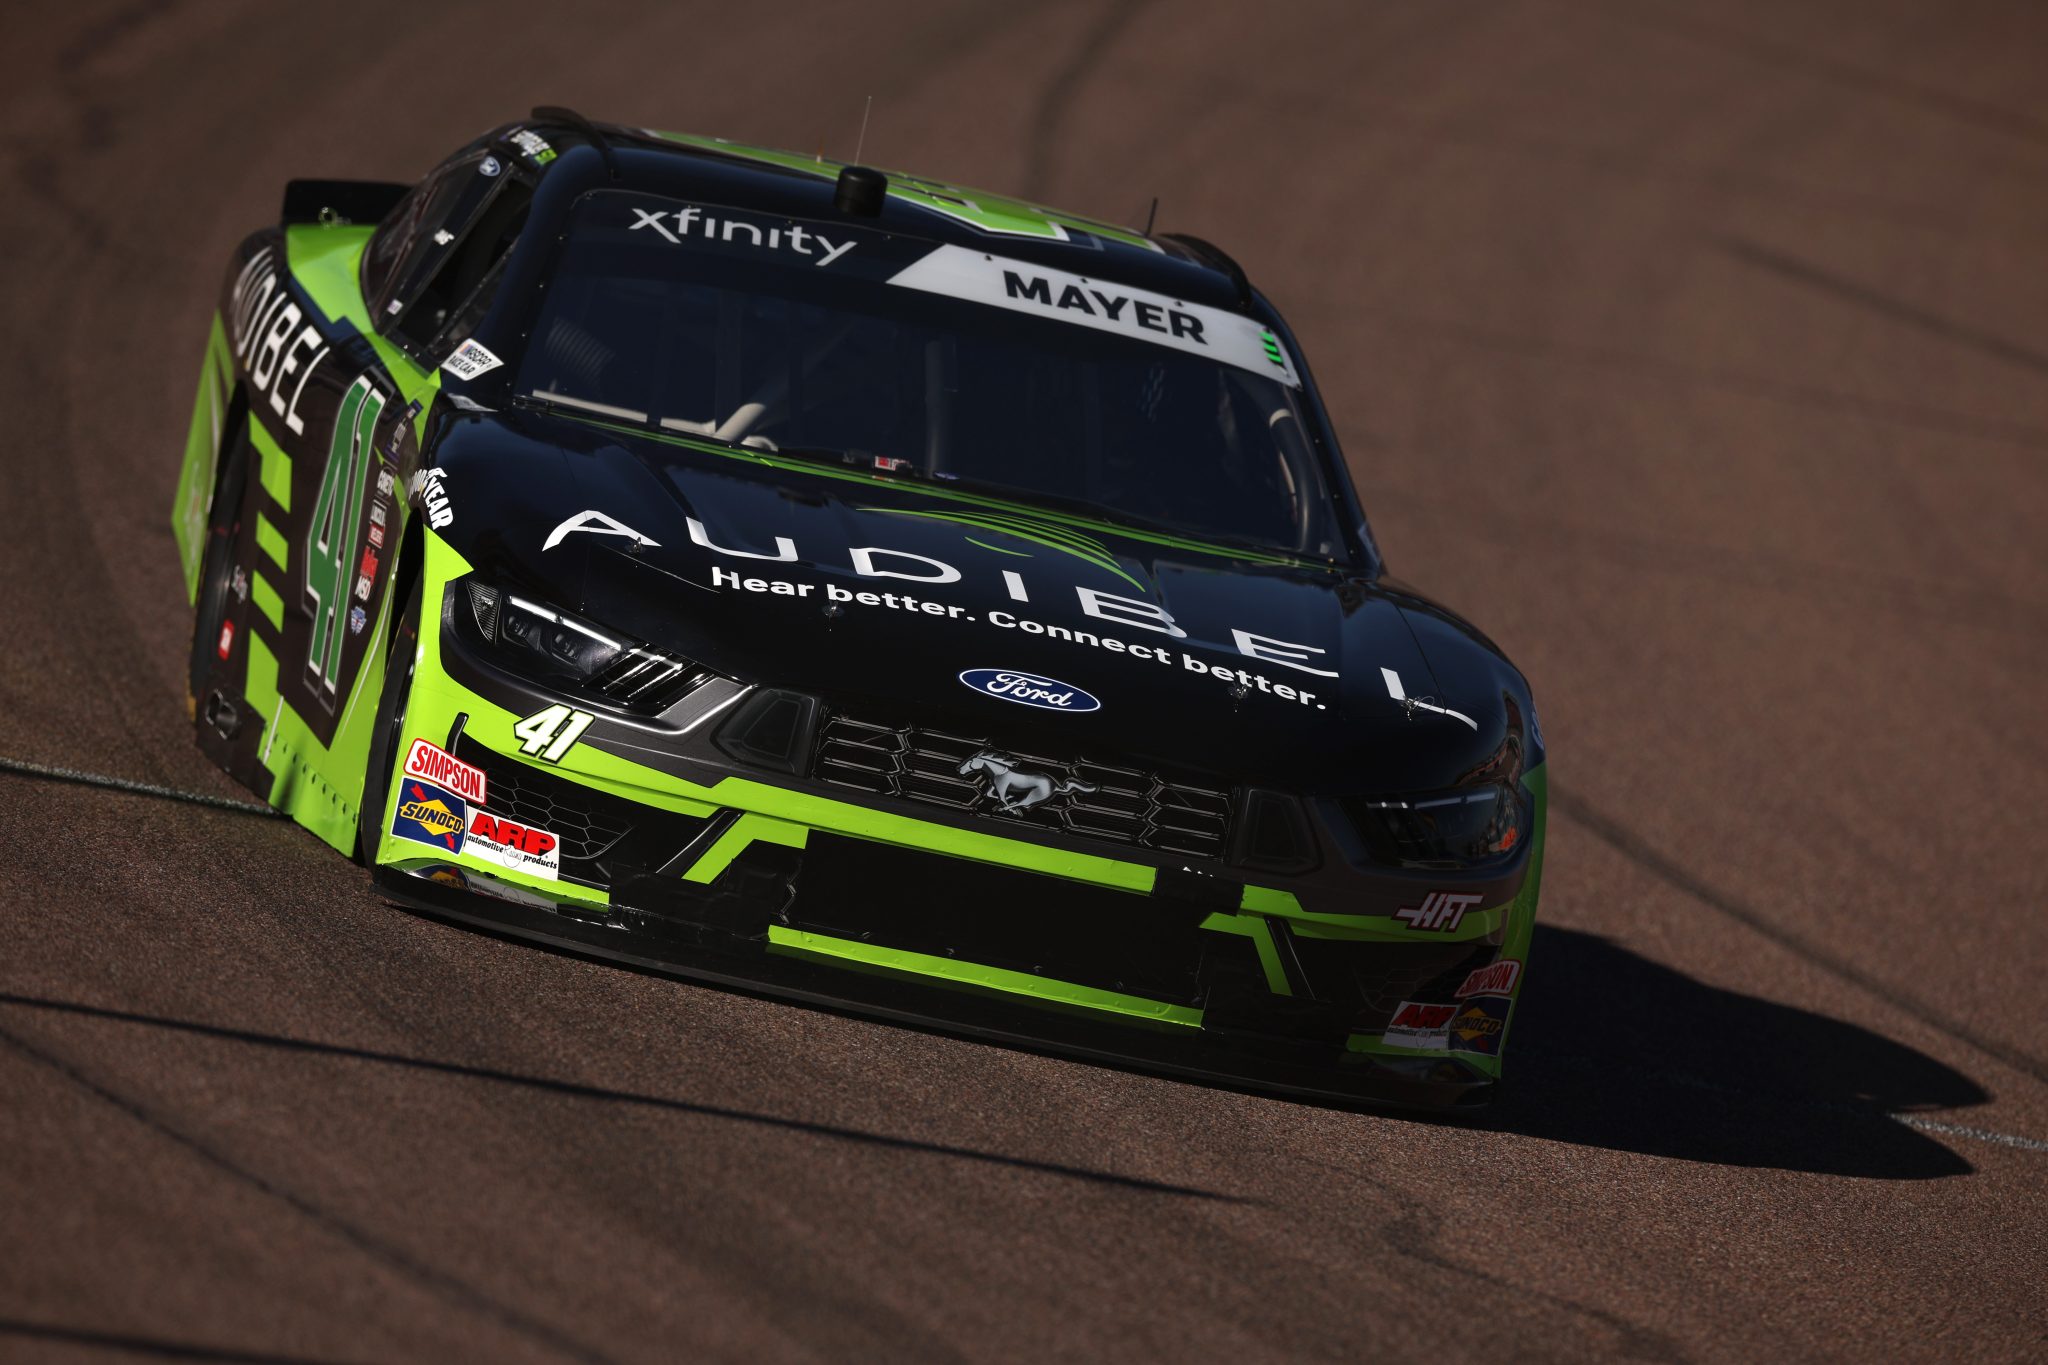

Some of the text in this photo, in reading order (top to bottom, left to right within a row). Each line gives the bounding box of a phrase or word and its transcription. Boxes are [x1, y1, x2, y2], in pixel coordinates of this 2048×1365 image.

[628, 207, 858, 267] xfinity
[1002, 269, 1209, 347] MAYER
[408, 467, 454, 531] YEAR
[541, 509, 1478, 732] AUDIBEL
[711, 566, 1326, 710] Hear better. Connect better.
[986, 673, 1074, 706] Ford
[515, 702, 596, 764] 41
[411, 745, 480, 799] SIMPSON
[402, 803, 463, 832] SUNOCO
[469, 812, 557, 857] ARP
[467, 835, 504, 854] automotive
[522, 854, 557, 870] products
